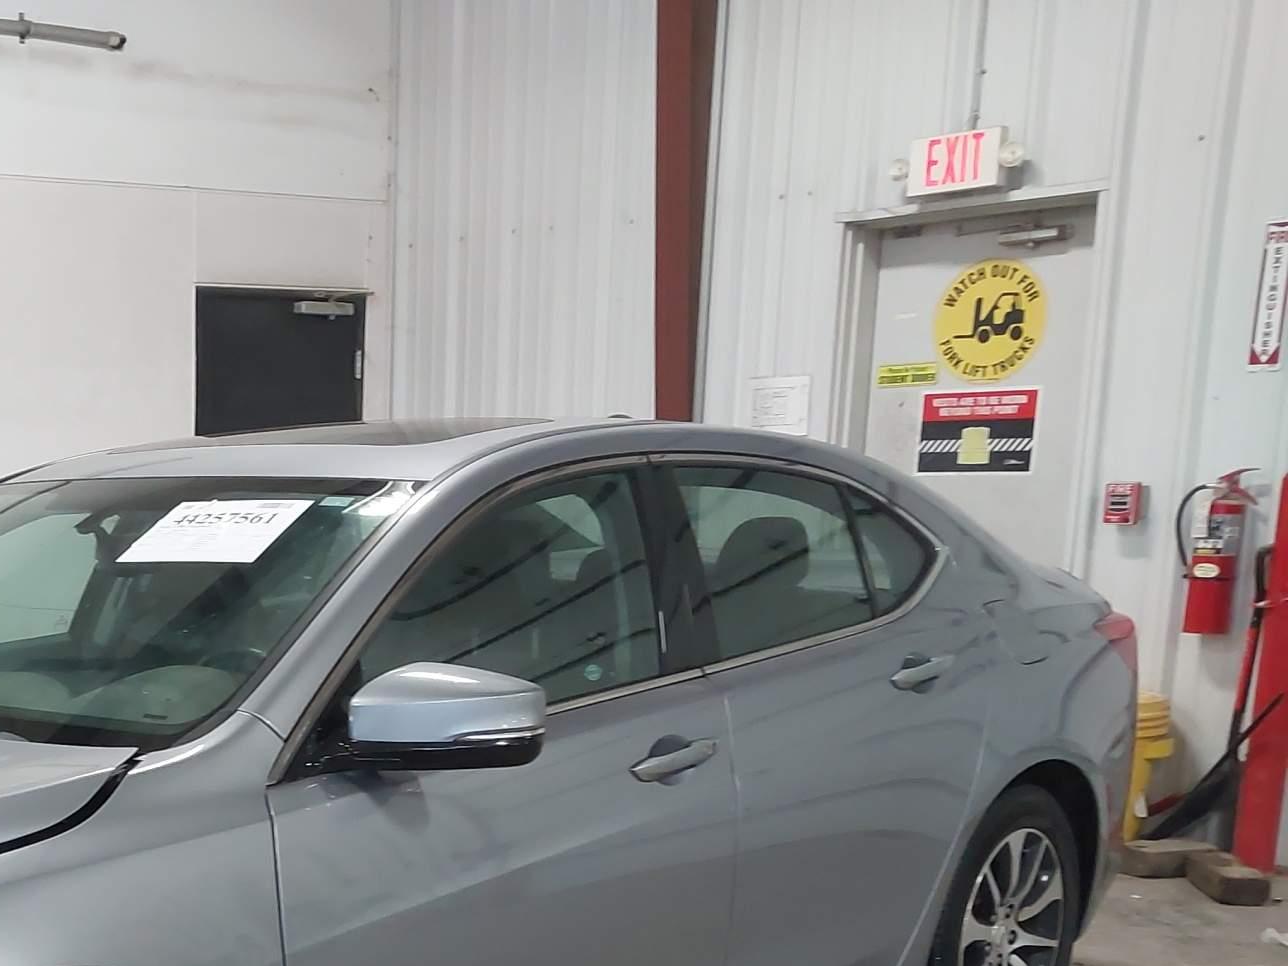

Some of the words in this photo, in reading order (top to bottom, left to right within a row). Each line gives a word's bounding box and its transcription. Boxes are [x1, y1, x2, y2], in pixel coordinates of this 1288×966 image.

[924, 131, 985, 187] EXIT
[943, 267, 987, 308] WATCH
[990, 264, 1019, 280] OUT
[1016, 274, 1040, 302] FOR
[1261, 246, 1285, 356] EXTINGUISHER
[939, 339, 964, 370] FORK
[962, 362, 988, 377] LIFT
[991, 336, 1035, 375] TRUCKS
[173, 511, 280, 525] 44257561
